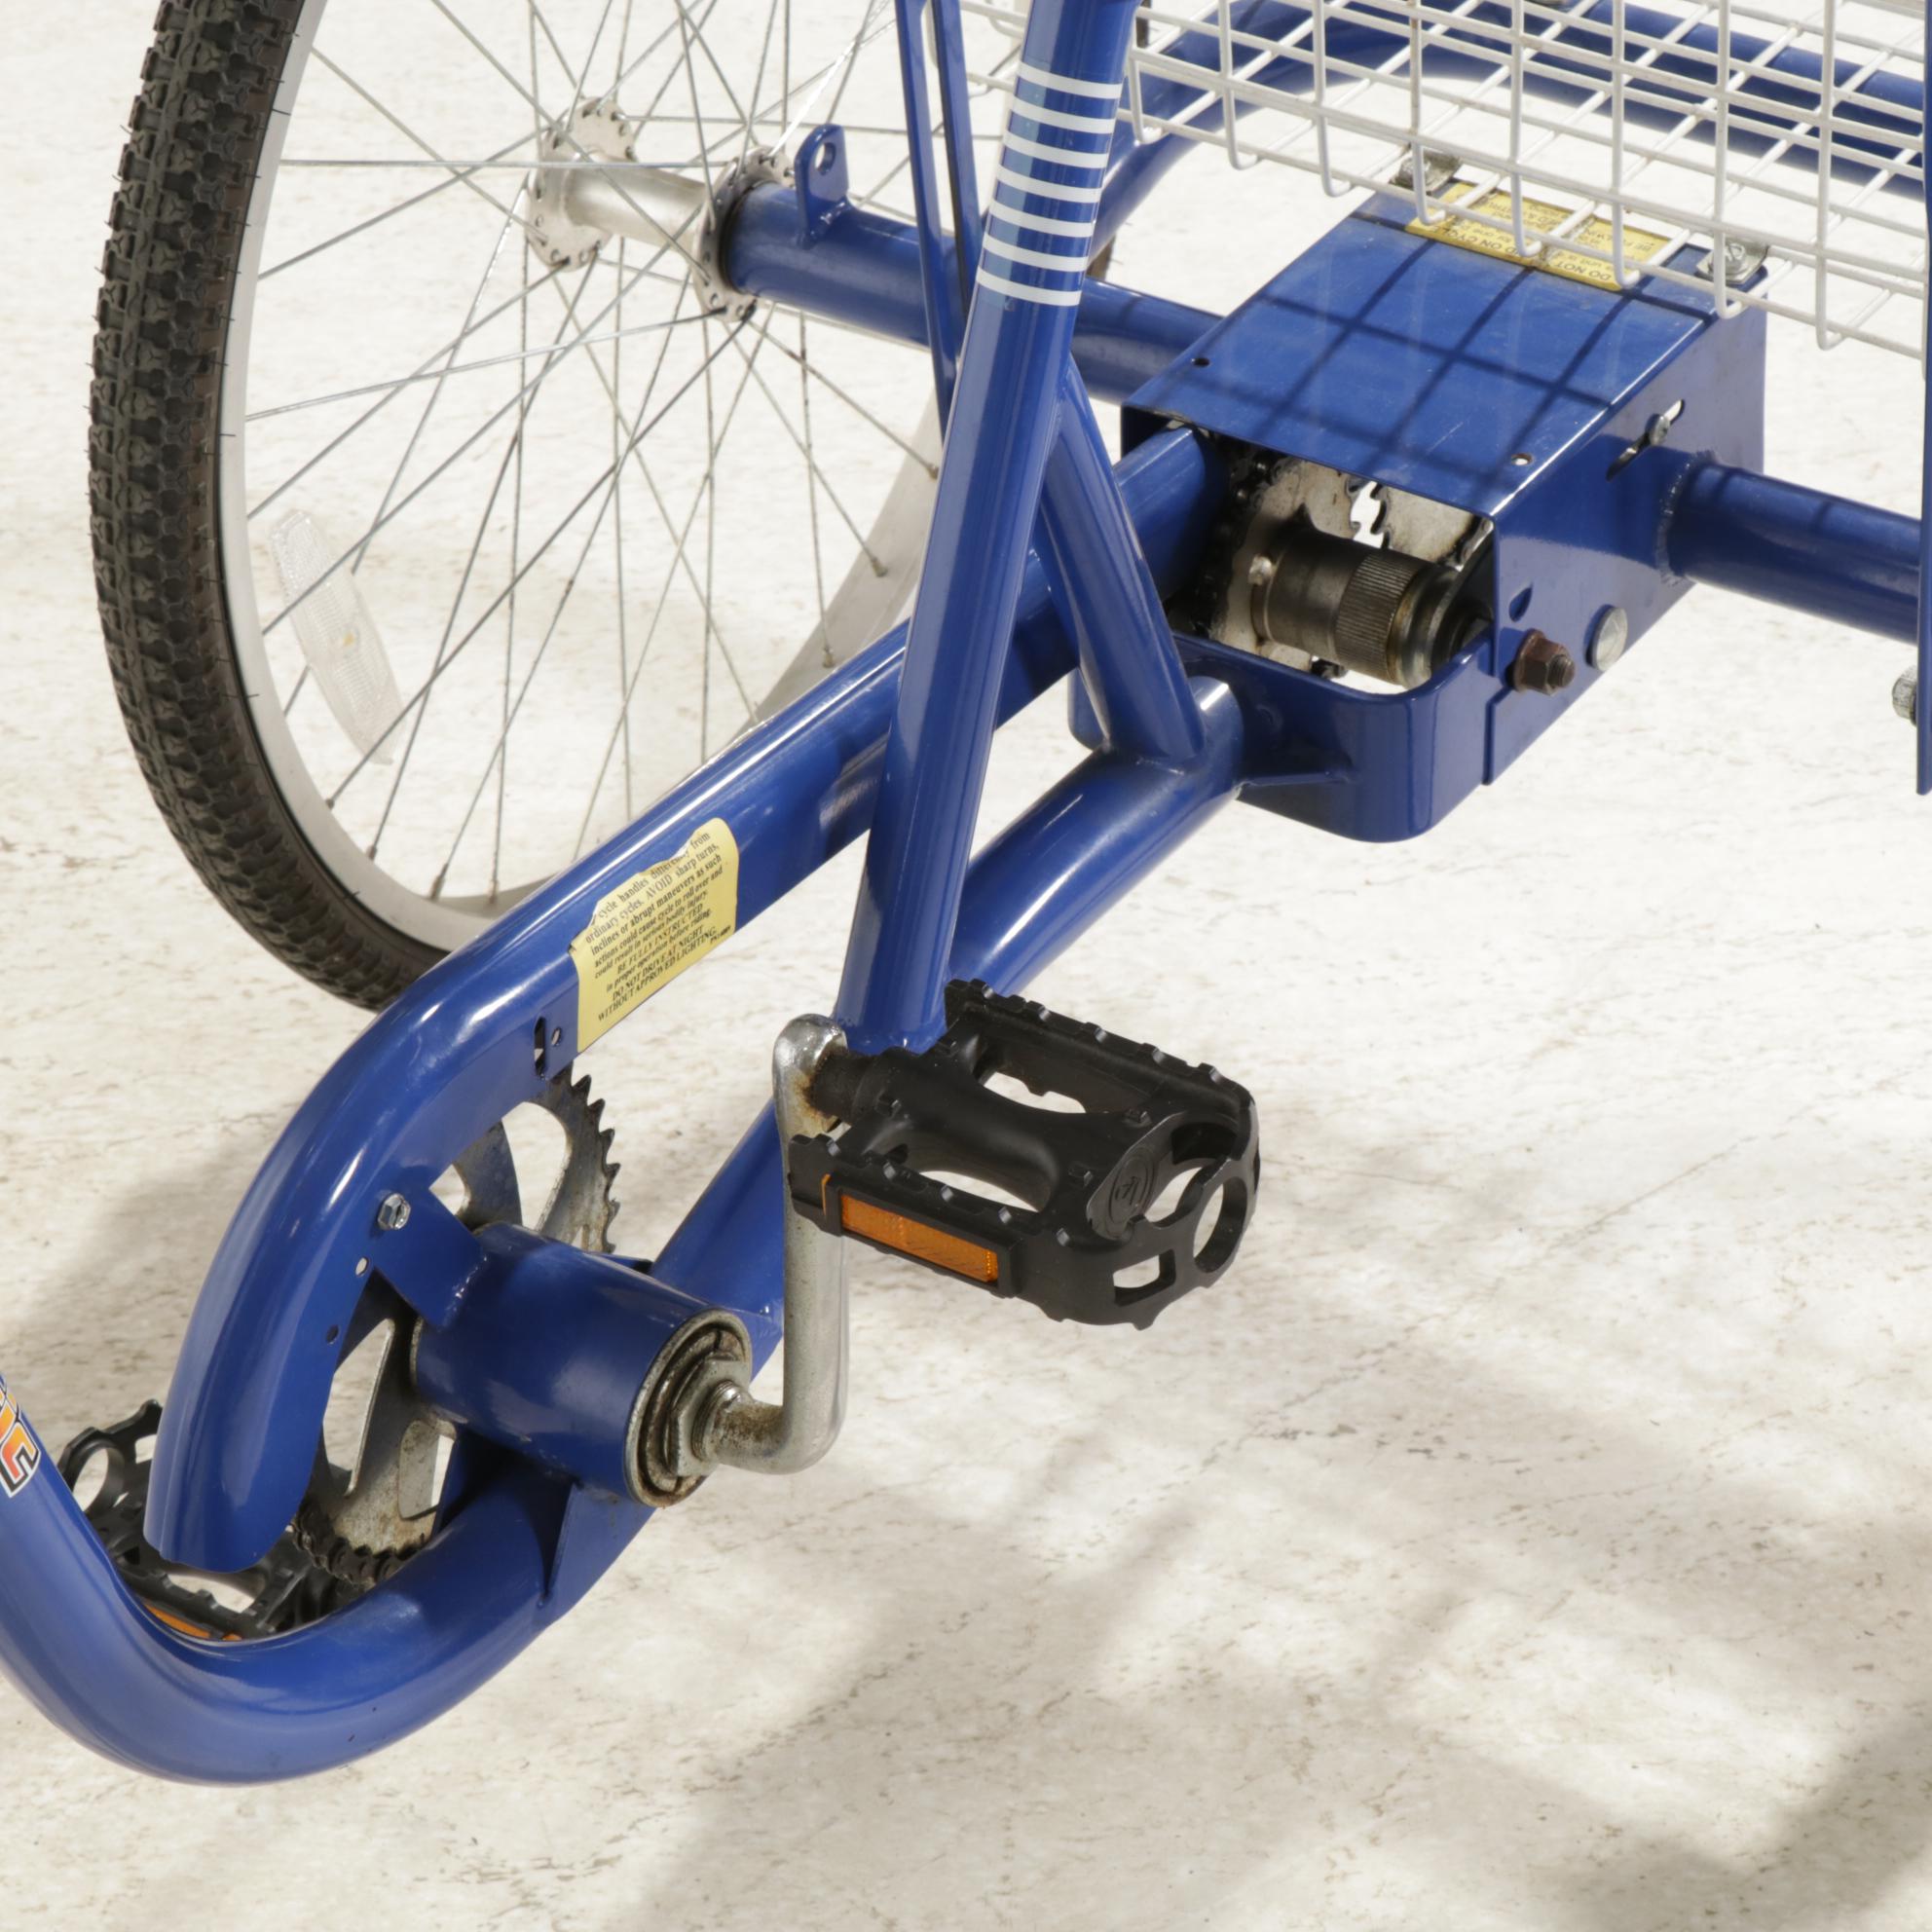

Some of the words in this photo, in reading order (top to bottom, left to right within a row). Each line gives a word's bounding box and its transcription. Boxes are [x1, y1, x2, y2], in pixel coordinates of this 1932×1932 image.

[1480, 239, 1502, 250] ON
[1555, 261, 1586, 274] NOT
[1589, 270, 1612, 281] DO
[585, 915, 618, 943] ordinary
[646, 873, 672, 900] AVOID
[675, 858, 696, 876] sharp
[590, 930, 618, 955] inclines
[619, 921, 628, 935] or
[630, 902, 654, 927] abrupt
[655, 873, 694, 909] maneuvers
[695, 866, 704, 878] as
[704, 853, 722, 871] such
[598, 901, 617, 917] cycle
[616, 878, 649, 904] handles
[689, 832, 710, 849] from
[595, 944, 617, 968] actions
[618, 927, 637, 949] could
[638, 915, 656, 935] cause
[657, 903, 674, 920] cycle
[674, 897, 681, 907] to
[710, 864, 723, 881] and
[598, 985, 633, 1022] WITHOUT
[636, 954, 675, 992] APPROVED
[613, 985, 623, 1001] DO
[625, 971, 640, 989] NOT
[679, 923, 702, 948] NIGHT
